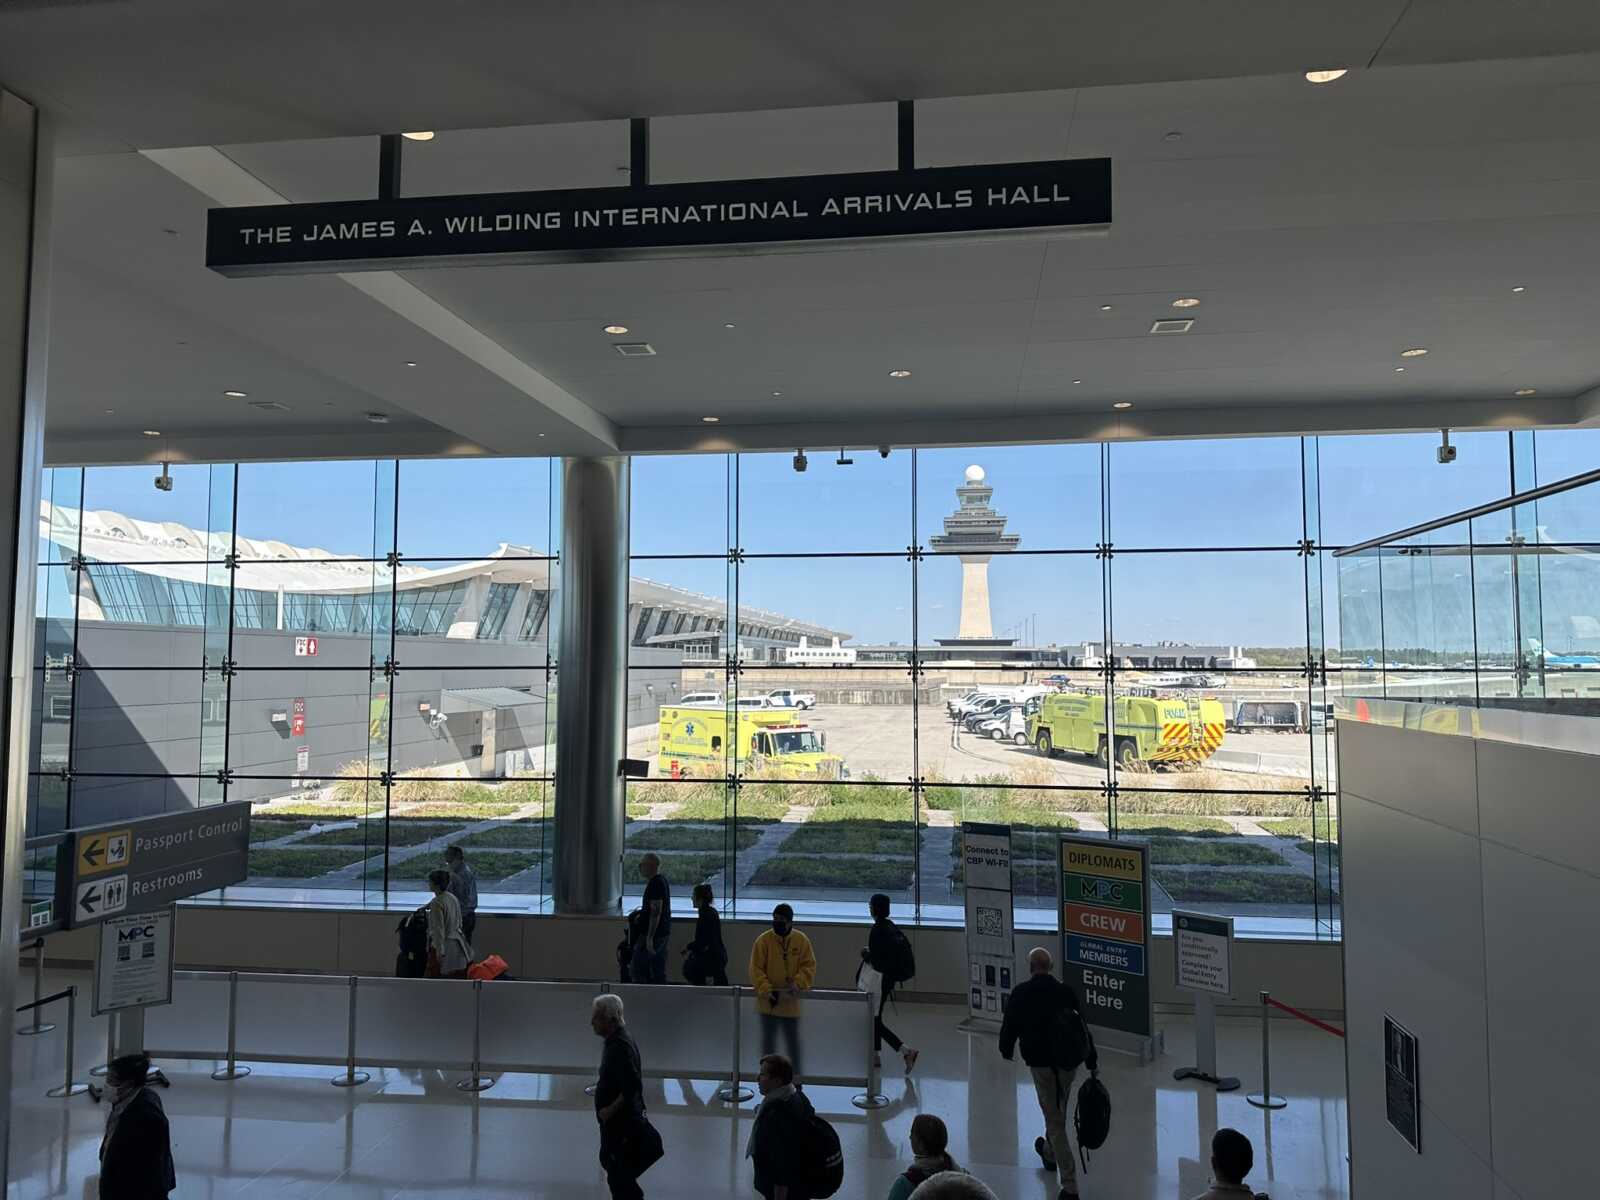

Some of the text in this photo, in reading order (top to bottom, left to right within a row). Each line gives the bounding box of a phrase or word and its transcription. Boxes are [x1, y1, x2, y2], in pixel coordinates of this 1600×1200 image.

[240, 184, 1070, 245] THE JAMES A. WILDING INTERNATIONAL ARRIVALS HALL
[135, 818, 243, 853] Passport Control
[966, 845, 1009, 856] Connect to
[966, 856, 984, 865] CBP
[1069, 851, 1136, 871] DIPLOMATS
[131, 867, 203, 897] Restrooms
[1081, 878, 1124, 902] MPC
[1080, 912, 1126, 933] CREW
[119, 925, 155, 942] MPC
[1080, 940, 1127, 955] GLOBAL ENTRY
[1079, 950, 1129, 968] MEMBERS
[1083, 969, 1126, 992] Enter
[1086, 988, 1124, 1011] Here
